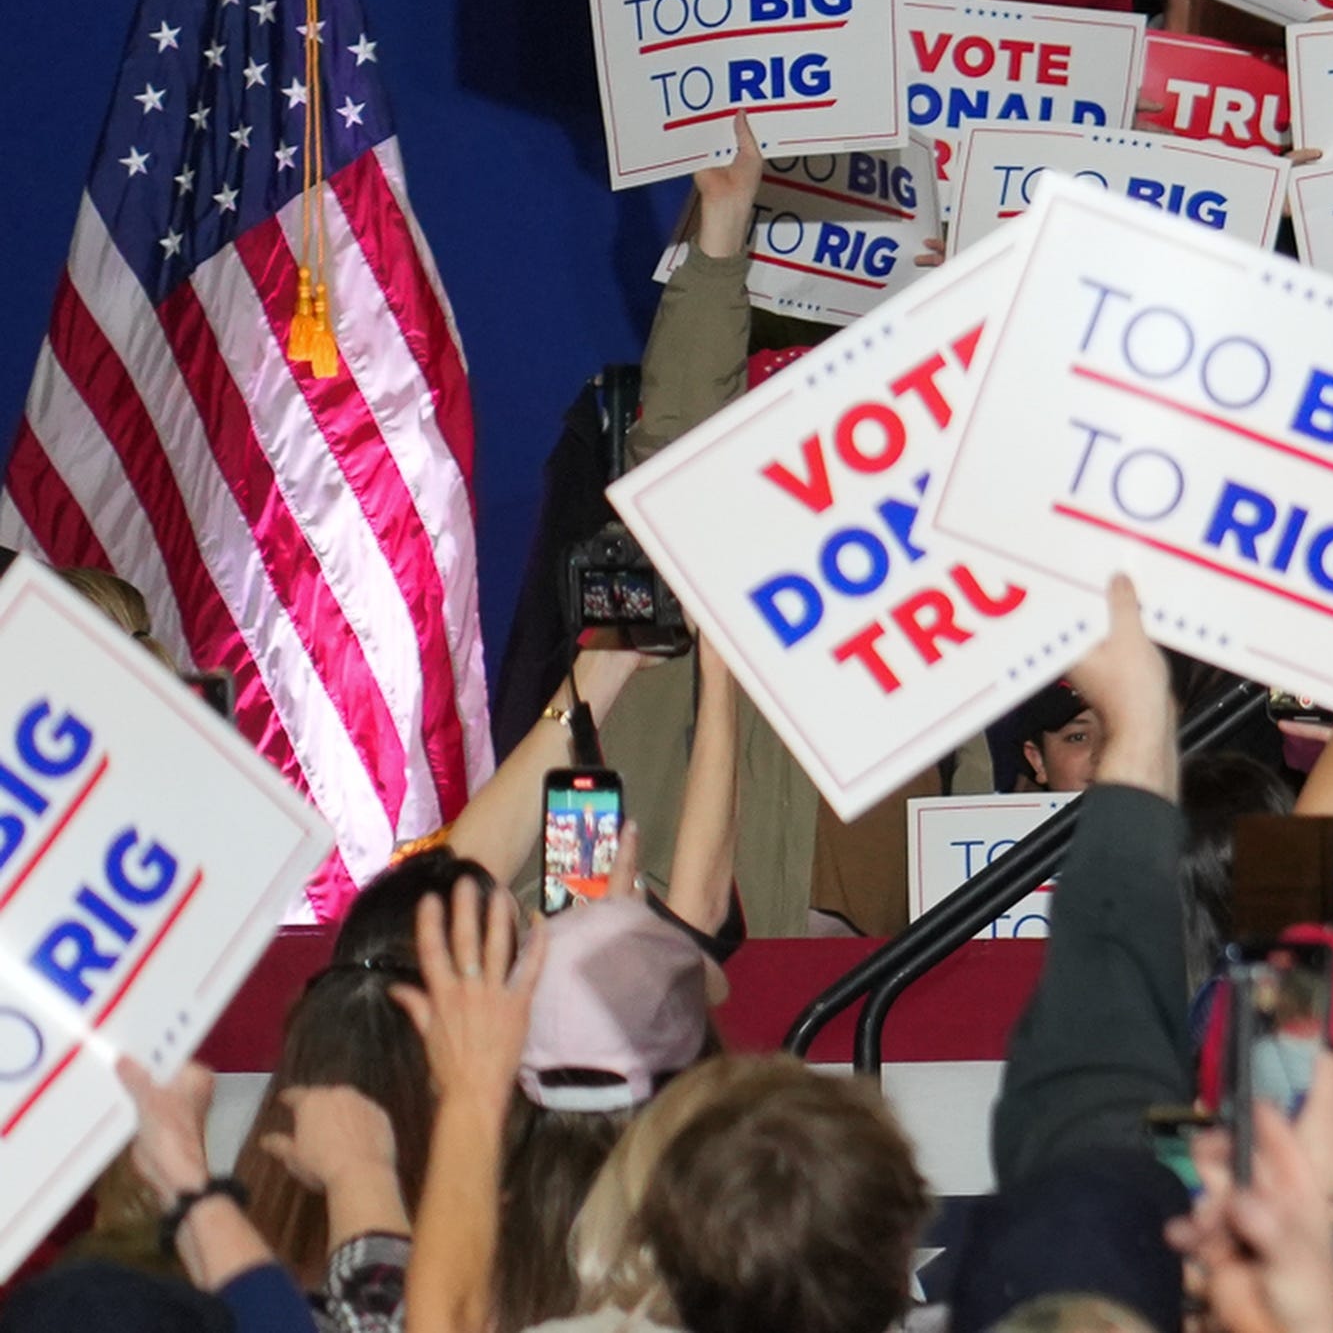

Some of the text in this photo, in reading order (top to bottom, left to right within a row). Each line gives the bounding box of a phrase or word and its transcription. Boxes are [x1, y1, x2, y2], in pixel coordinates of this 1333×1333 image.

[650, 53, 832, 116] TO RIG
[909, 30, 1072, 86] VOTE
[847, 152, 917, 209] BIG
[1127, 177, 1228, 230] BIG
[749, 203, 899, 278] TO RIG
[1071, 277, 1272, 409] TOO
[1066, 417, 1185, 520] TO
[29, 826, 178, 1007] RIG
